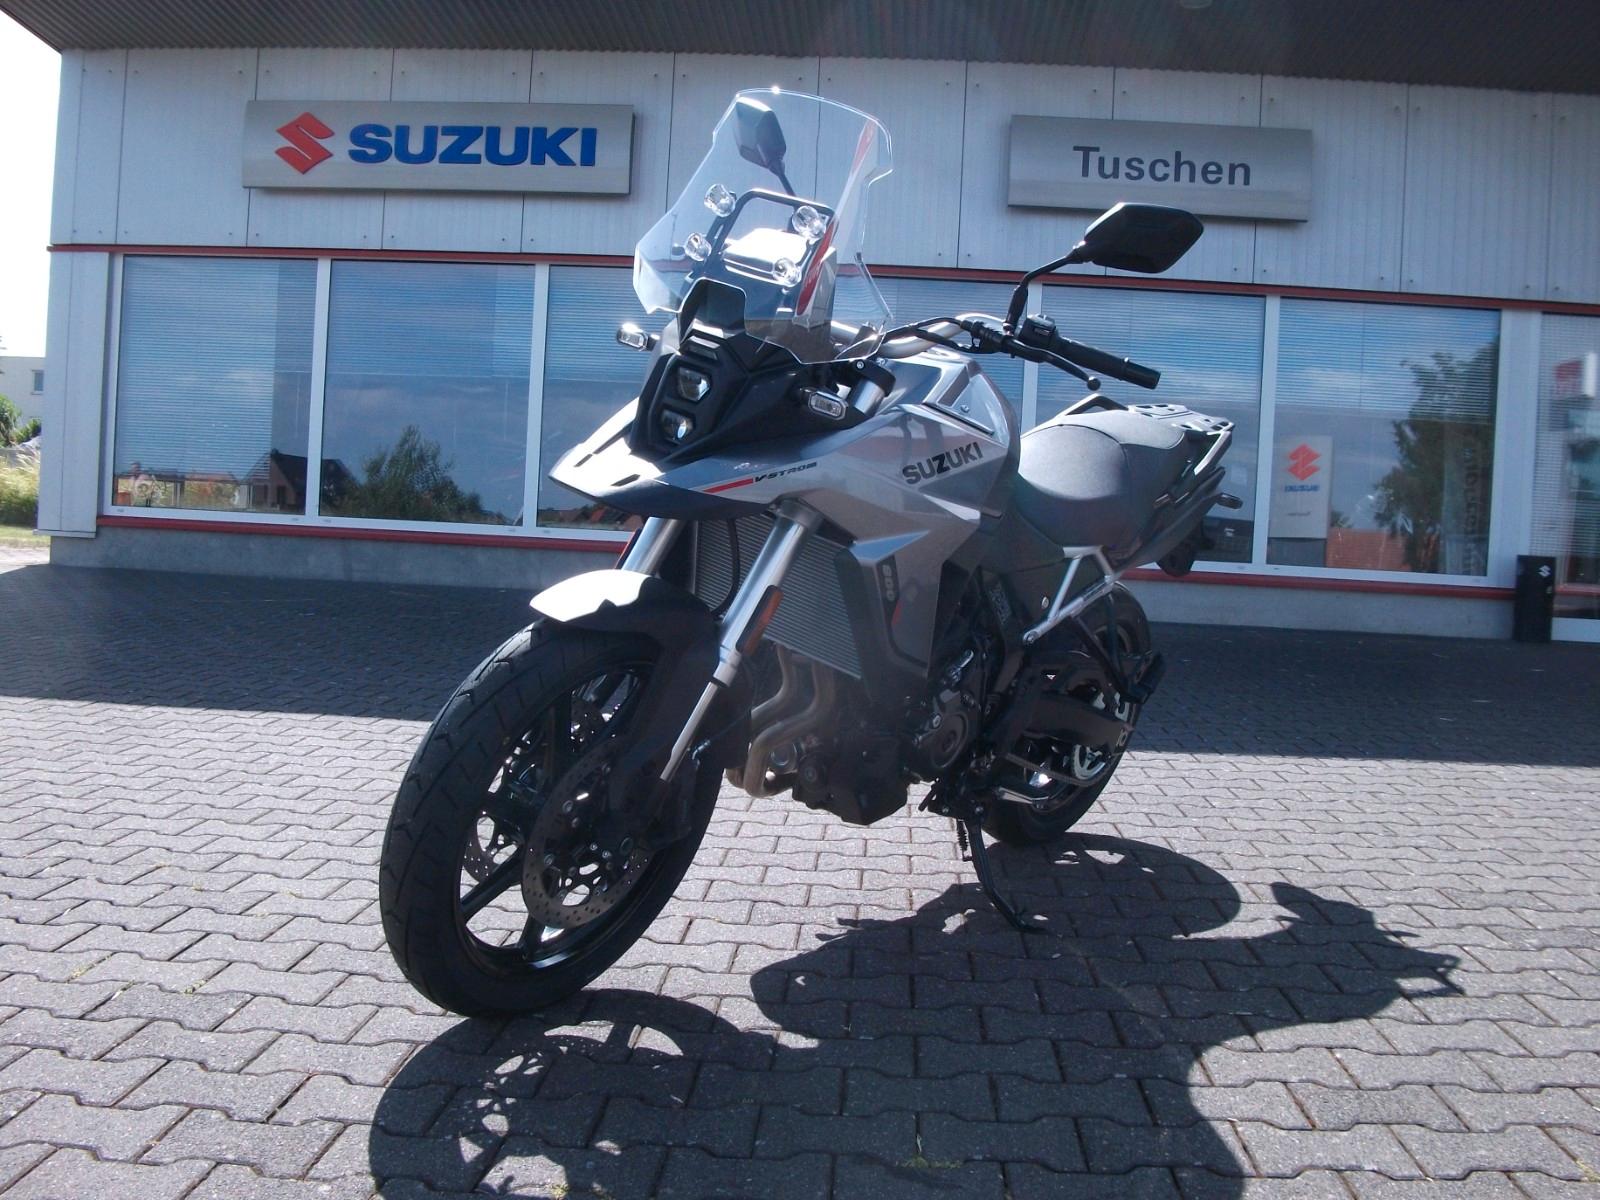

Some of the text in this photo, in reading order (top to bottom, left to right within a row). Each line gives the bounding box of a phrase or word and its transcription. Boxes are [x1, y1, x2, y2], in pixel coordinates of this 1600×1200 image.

[348, 123, 598, 167] SUZUKI
[1072, 145, 1251, 186] Tuschen
[902, 441, 984, 485] SUZUKI
